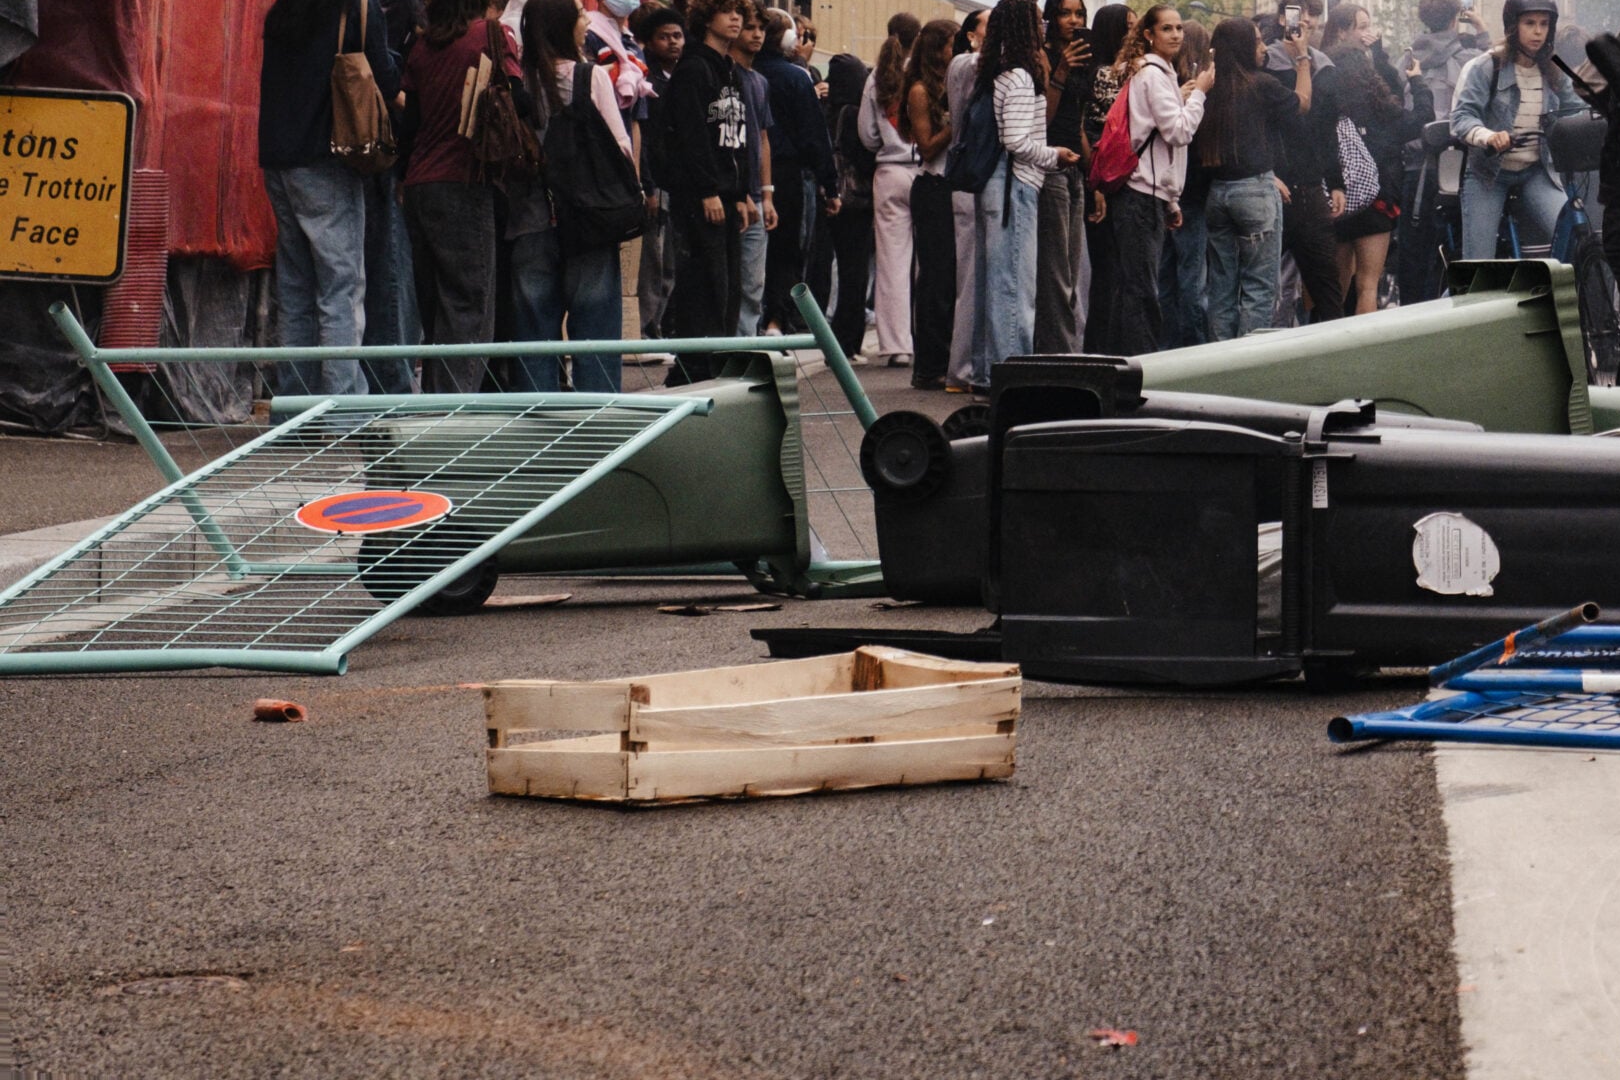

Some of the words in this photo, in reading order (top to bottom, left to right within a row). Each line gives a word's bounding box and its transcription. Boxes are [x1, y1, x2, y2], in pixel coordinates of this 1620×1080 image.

[2, 129, 79, 160] tons
[22, 172, 117, 202] Trottoir
[10, 216, 79, 246] Face
